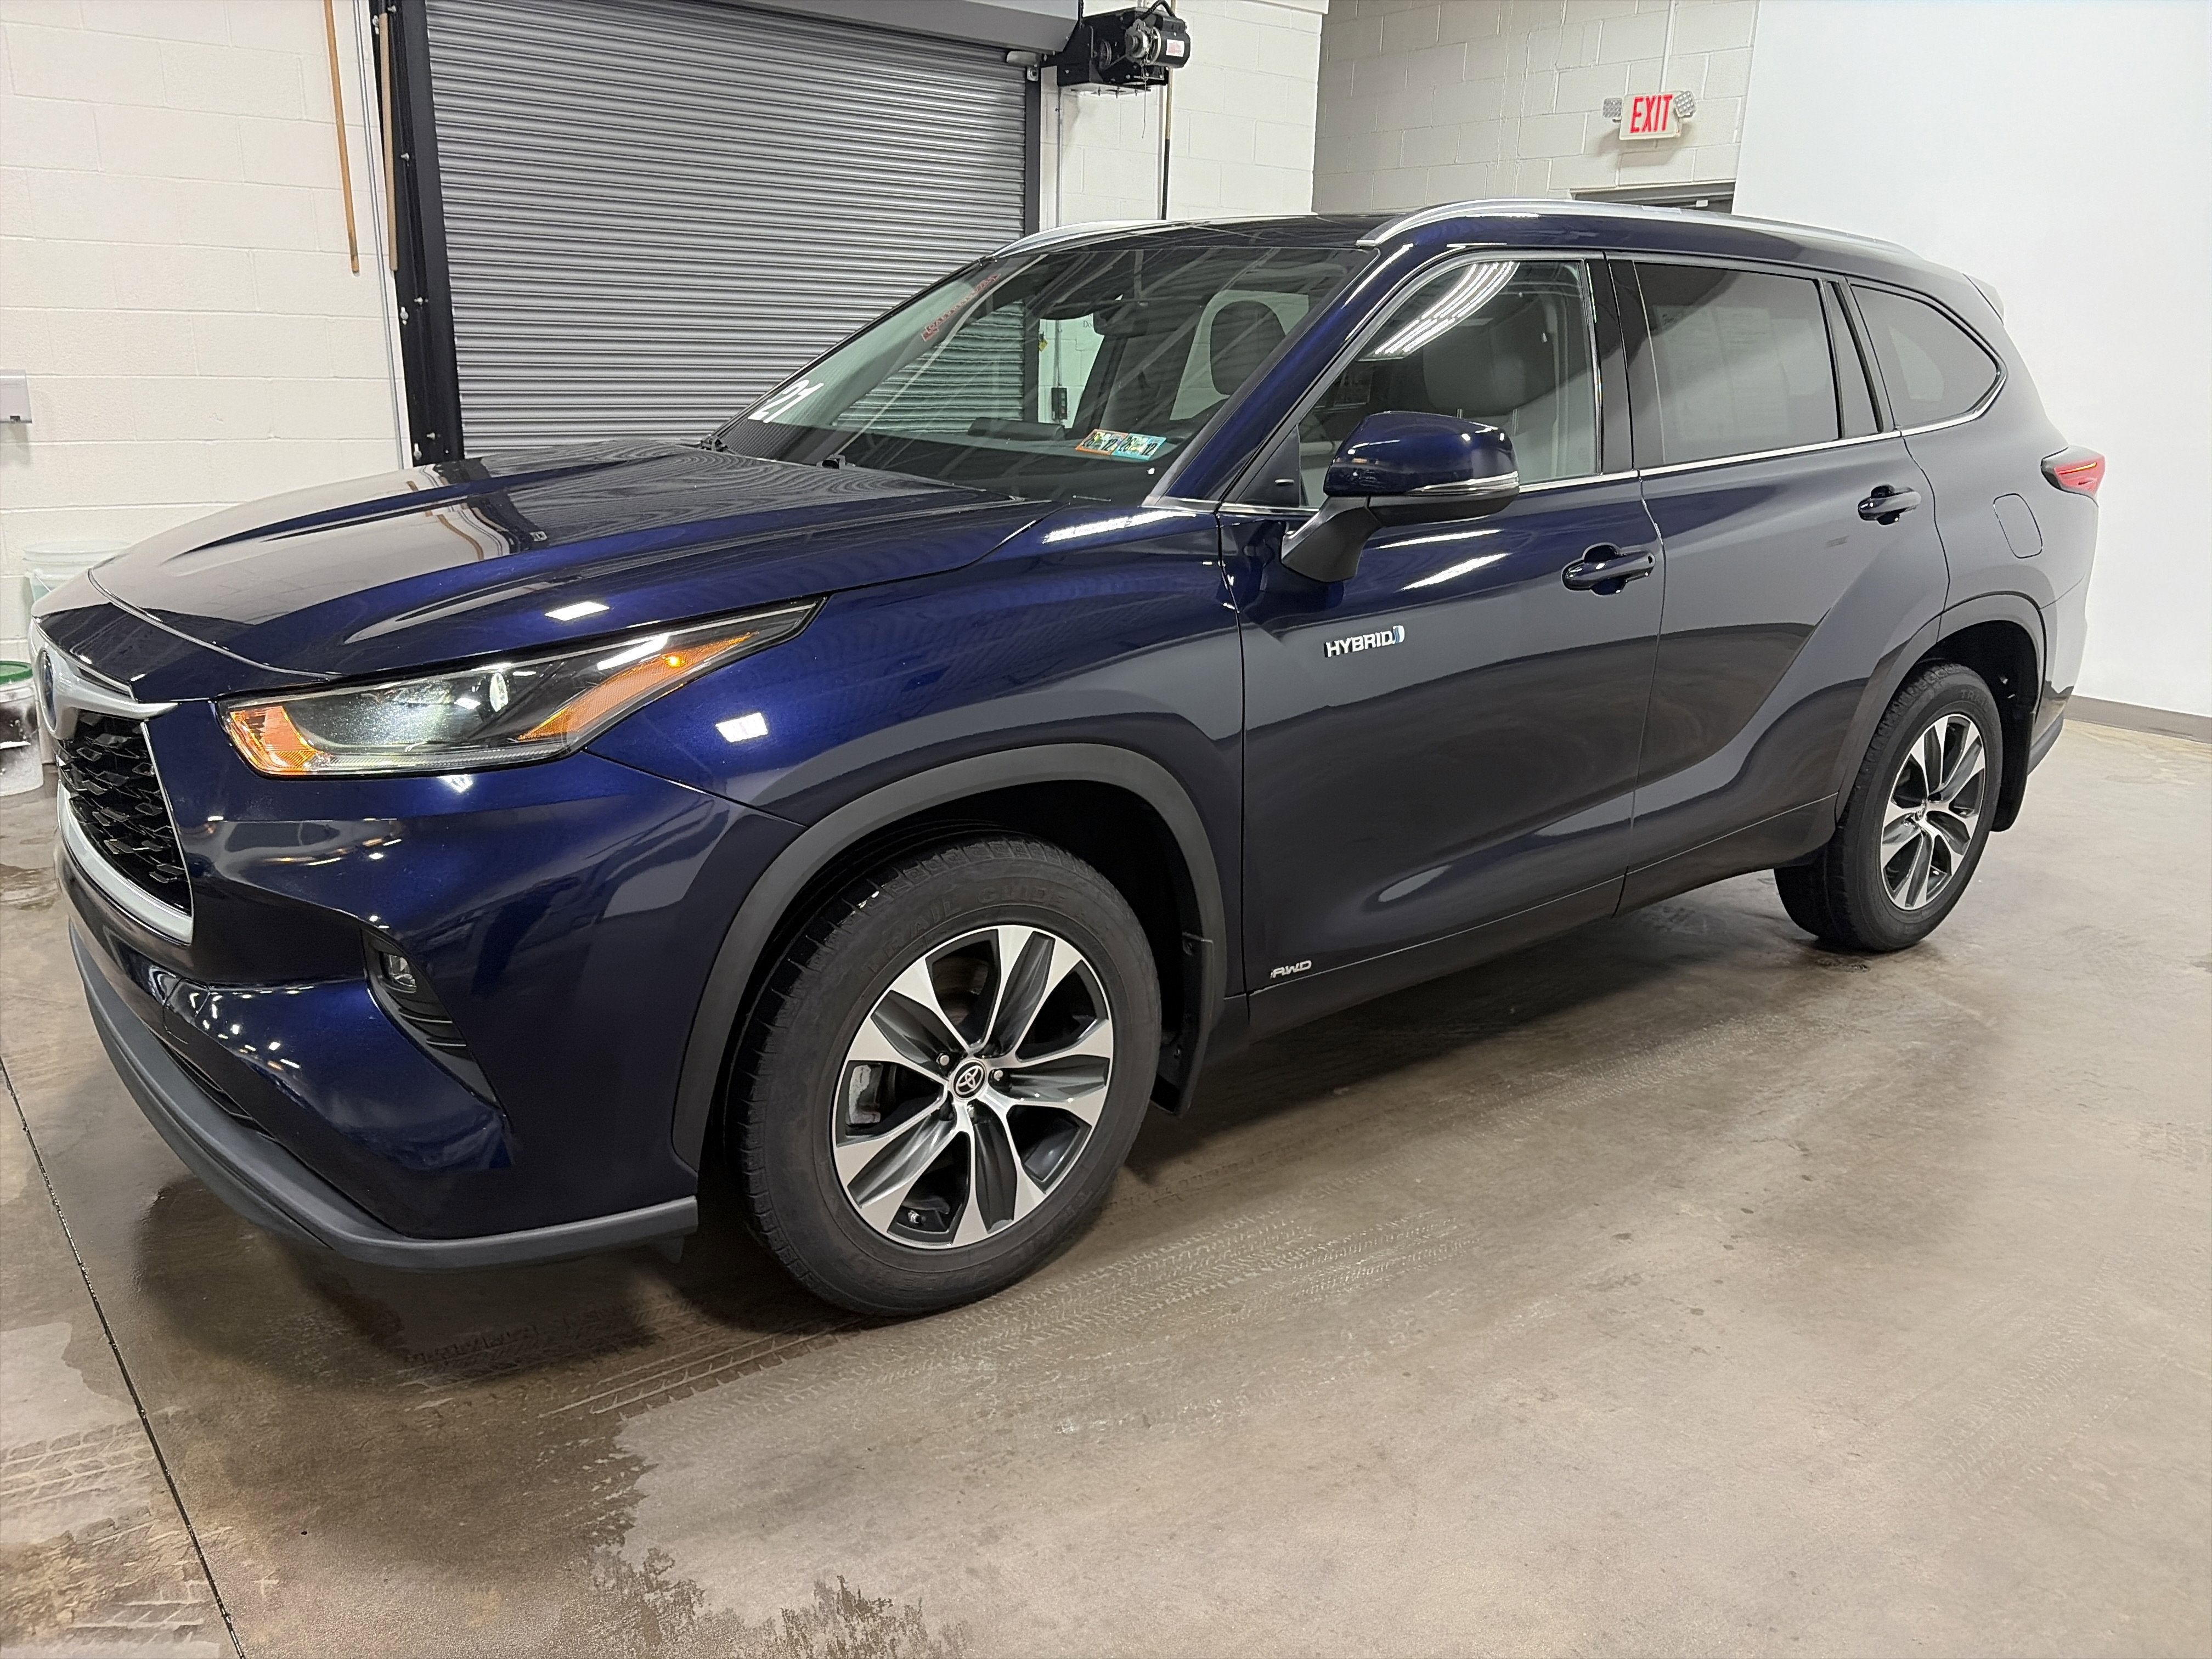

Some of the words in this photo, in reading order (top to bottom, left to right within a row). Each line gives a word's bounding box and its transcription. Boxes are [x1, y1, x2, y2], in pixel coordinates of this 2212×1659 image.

[1630, 94, 1673, 133] EXIT
[1101, 438, 1118, 451] 12
[1141, 443, 1158, 456] 12
[1325, 630, 1395, 658] HYBRID
